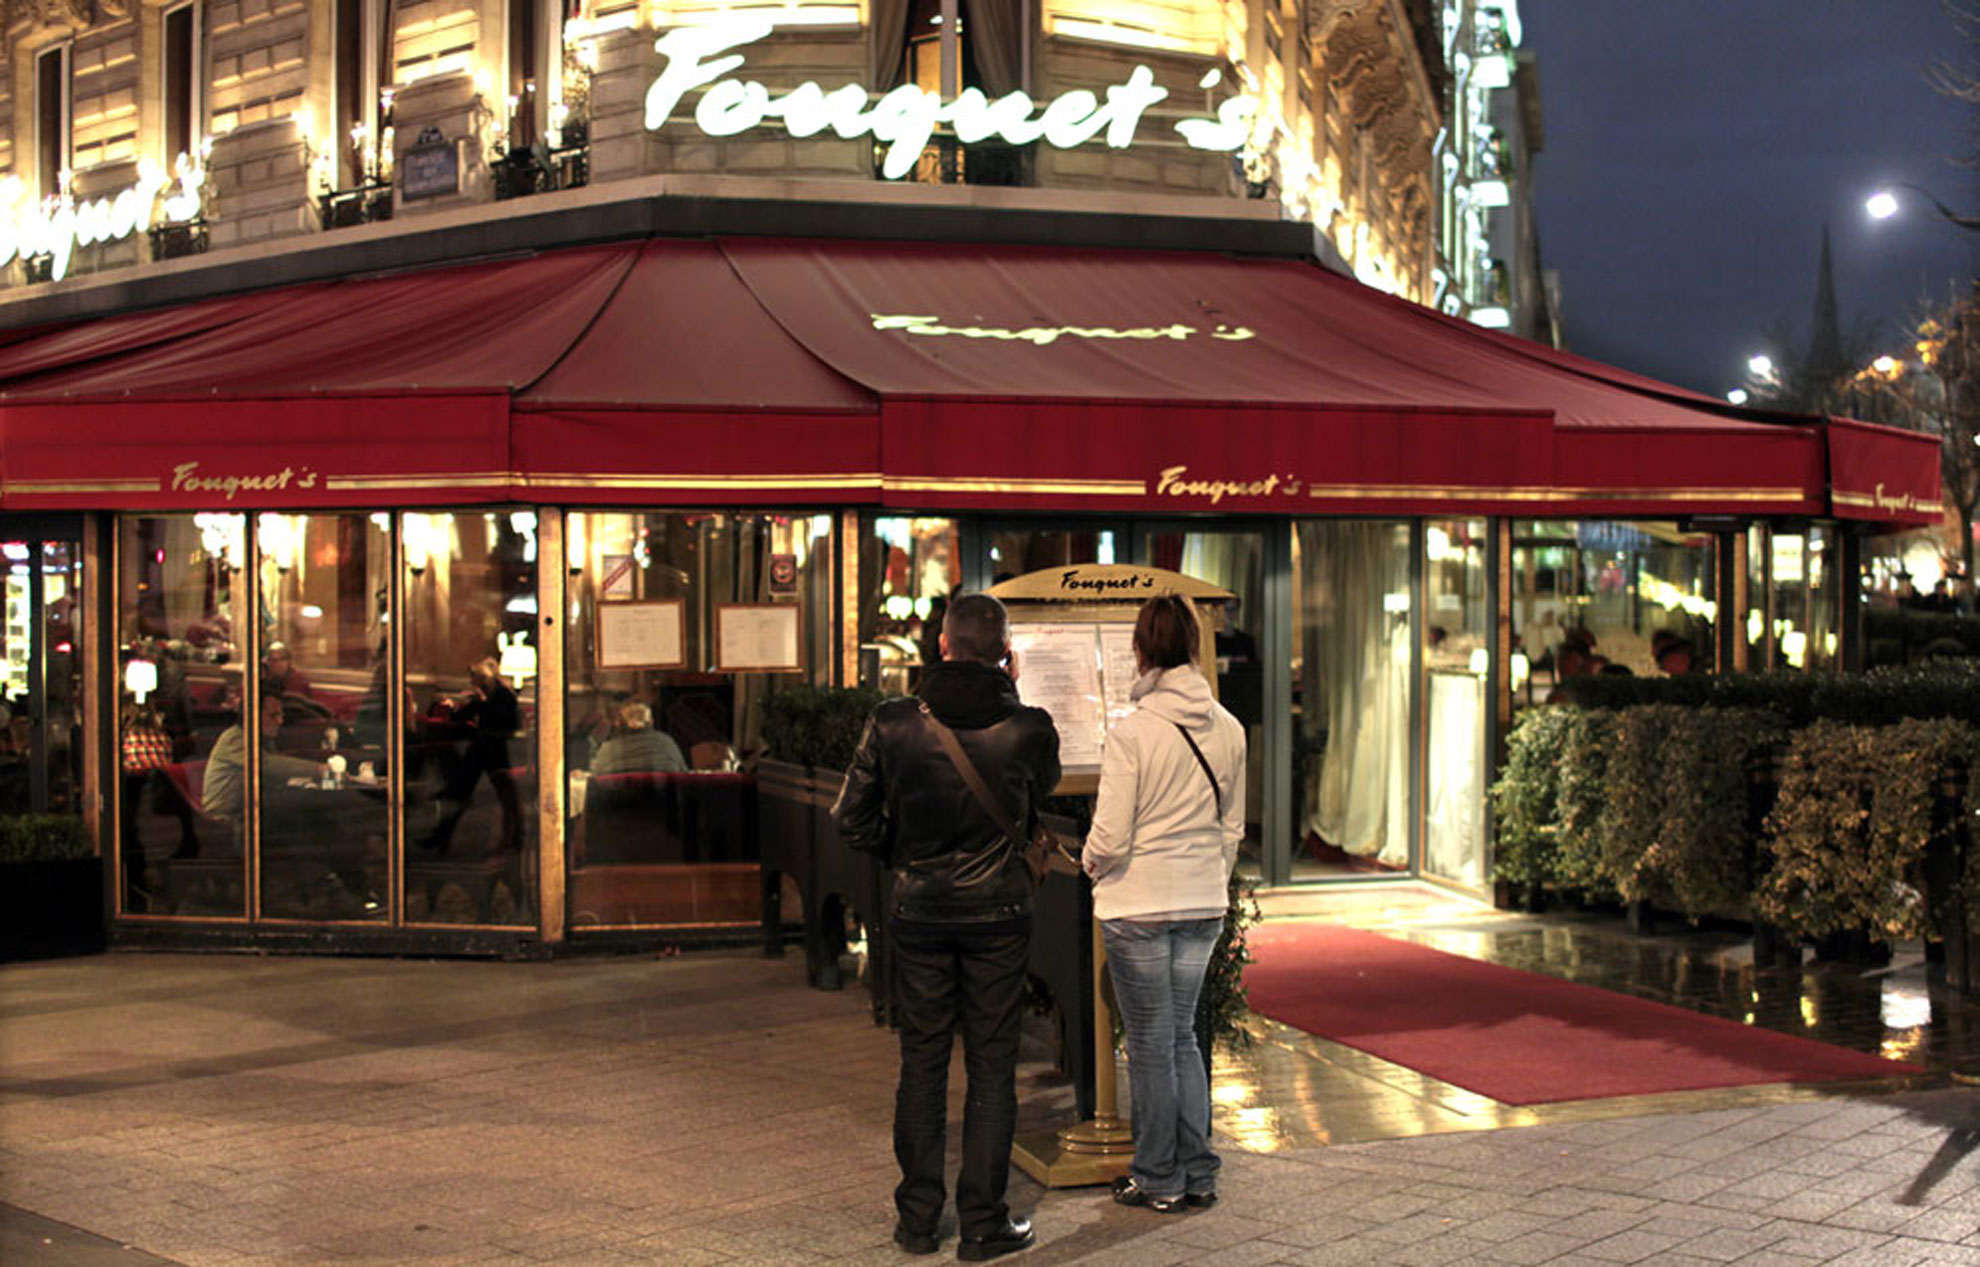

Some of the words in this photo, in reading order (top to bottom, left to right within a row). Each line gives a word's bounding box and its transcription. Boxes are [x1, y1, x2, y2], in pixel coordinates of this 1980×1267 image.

[644, 22, 1263, 179] Fouquet's
[172, 461, 317, 501] Fouquet's
[1157, 465, 1302, 504] Fouquet's
[1060, 570, 1154, 593] Fouquet's
